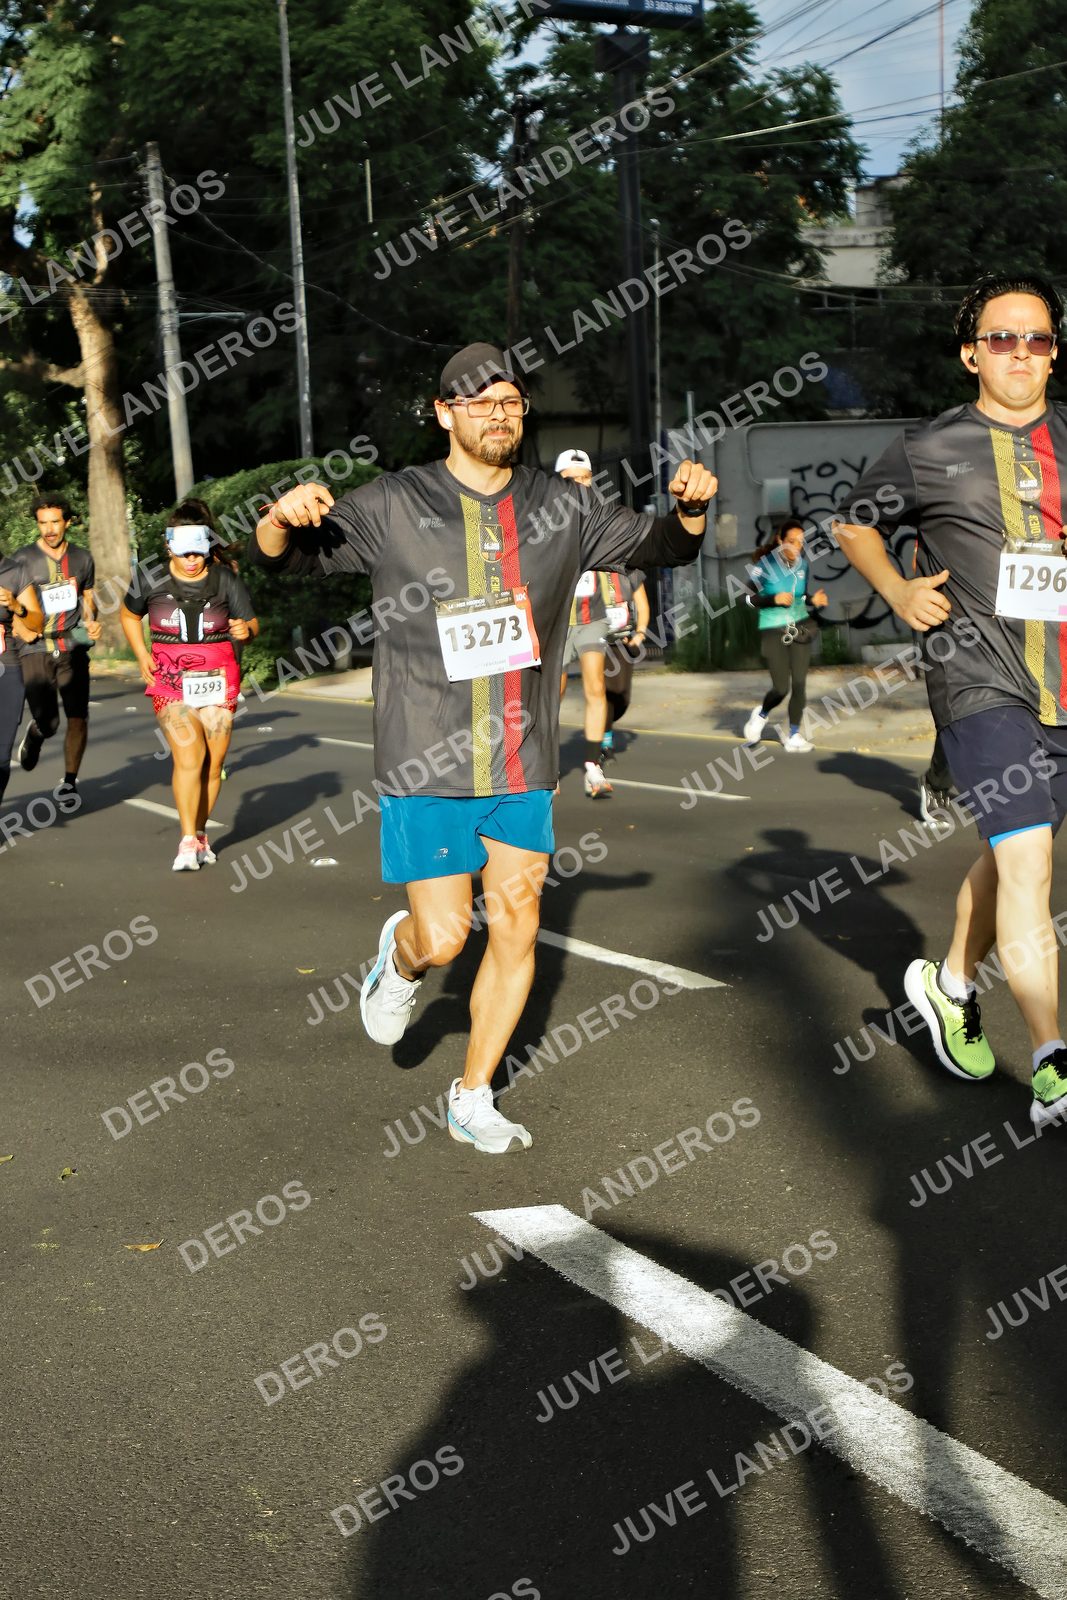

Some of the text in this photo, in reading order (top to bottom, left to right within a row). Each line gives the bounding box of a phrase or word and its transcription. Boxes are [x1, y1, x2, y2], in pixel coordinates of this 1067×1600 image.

[791, 456, 867, 481] TOY
[445, 615, 522, 652] 13273
[188, 681, 222, 696] 12593
